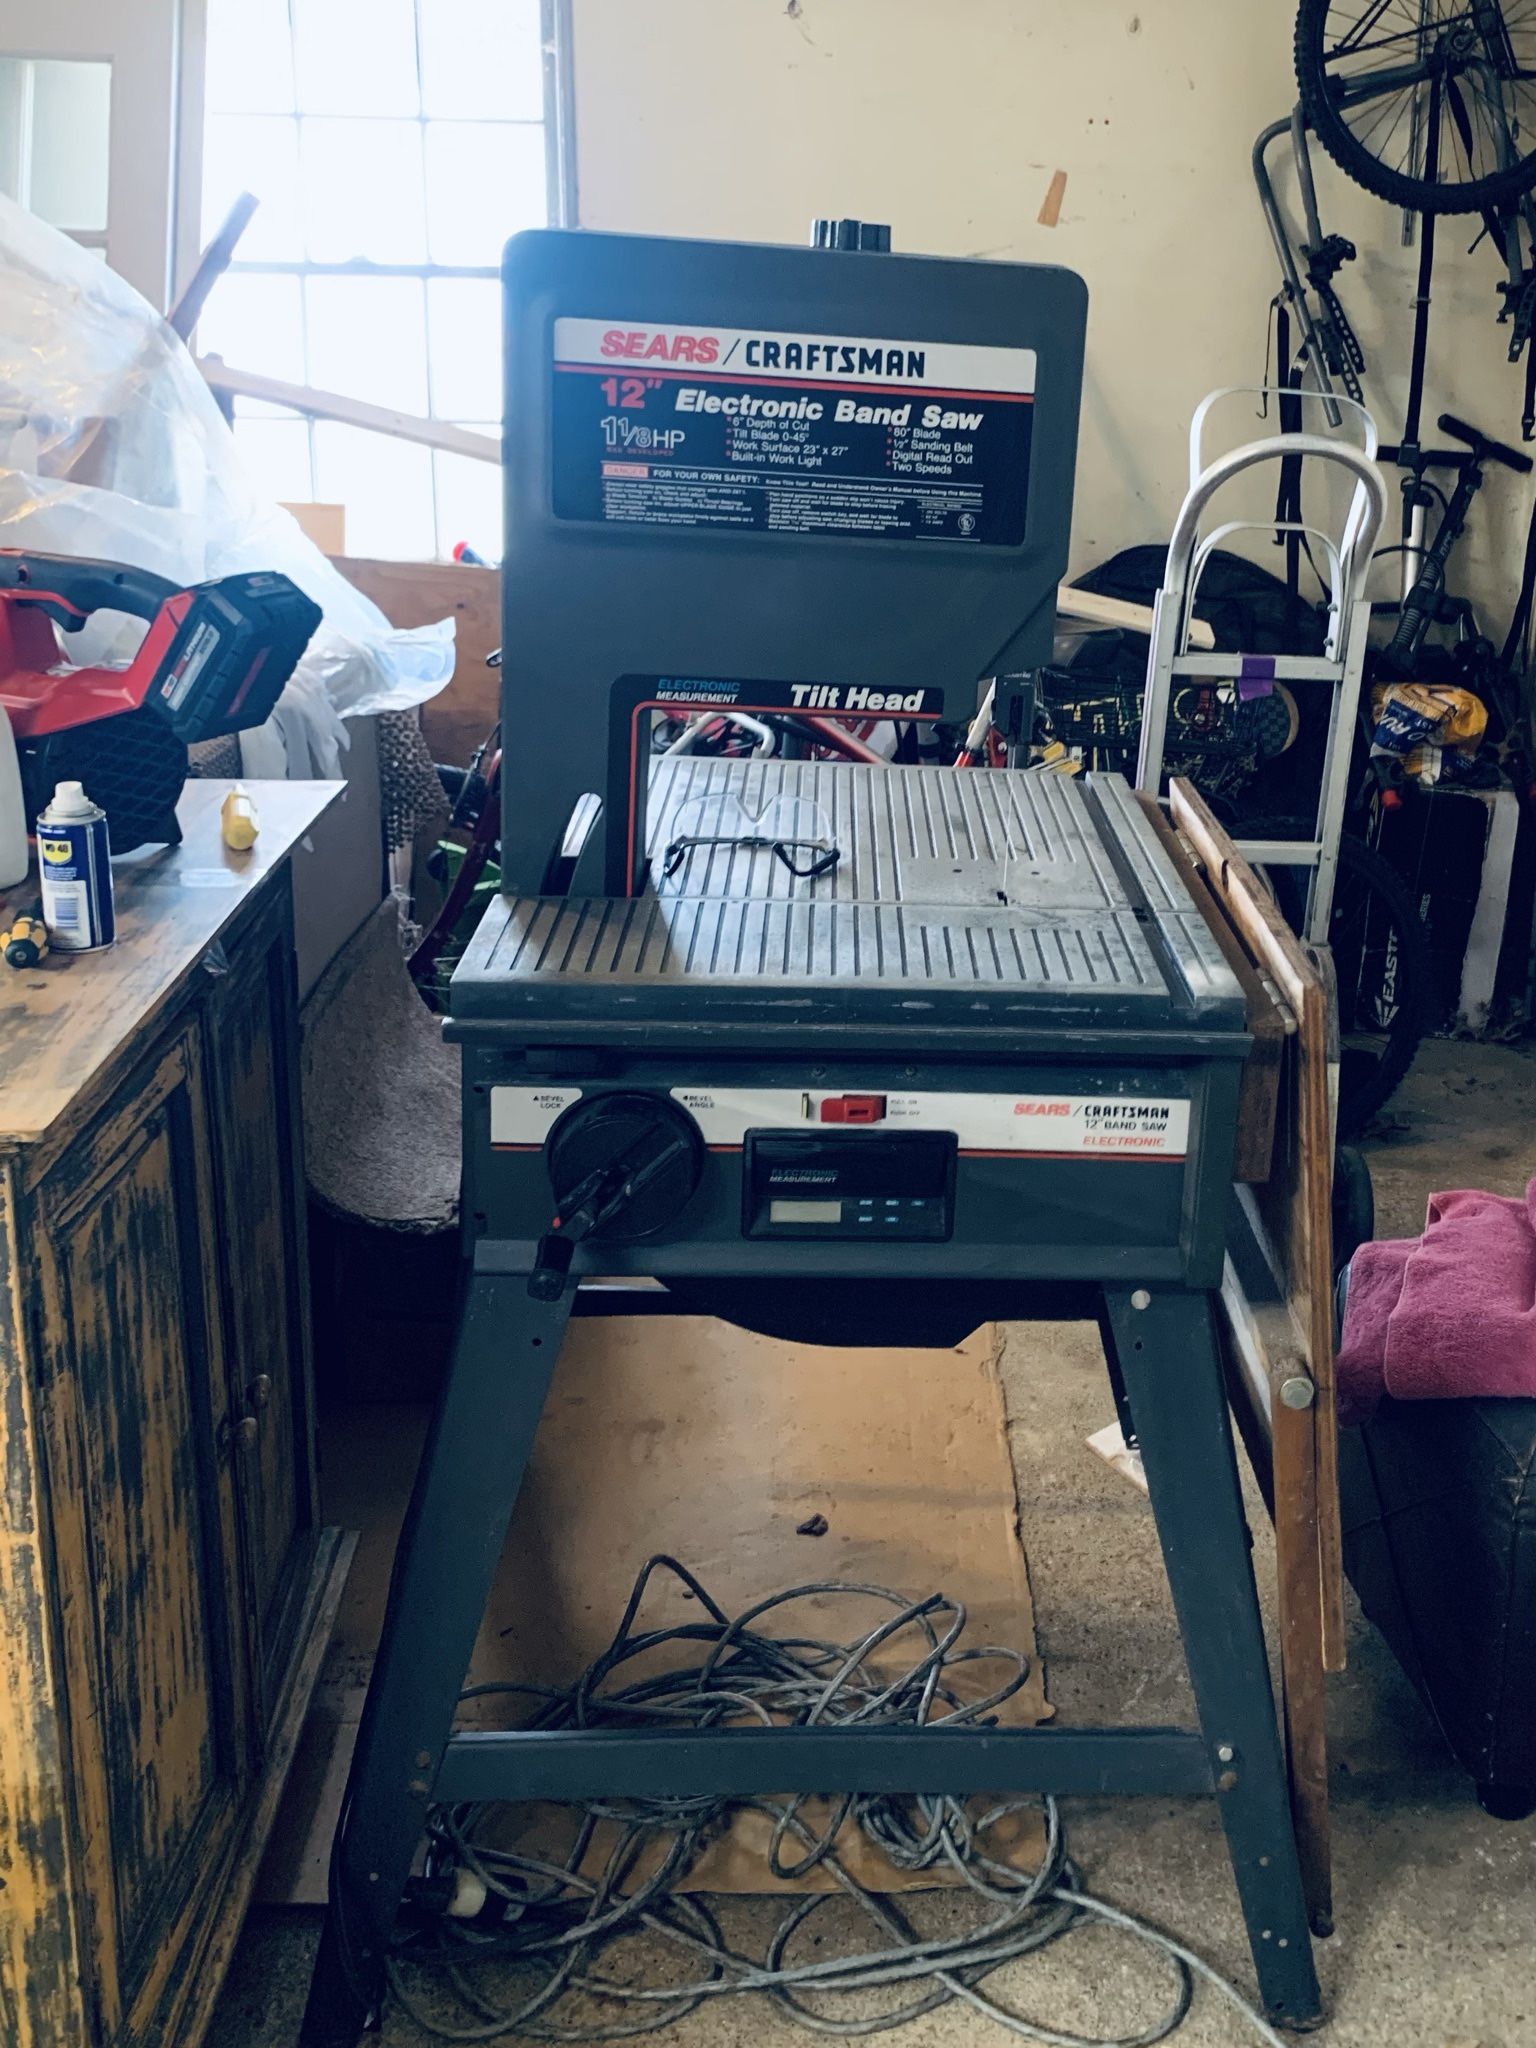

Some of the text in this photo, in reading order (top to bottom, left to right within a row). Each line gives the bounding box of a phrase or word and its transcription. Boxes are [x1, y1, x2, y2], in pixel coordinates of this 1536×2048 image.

[601, 330, 721, 365] SEARS
[745, 339, 926, 379] CRAFTSMAN
[600, 377, 664, 409] 12"
[674, 387, 985, 431] Electronic Band Saw
[746, 417, 776, 430] Depth
[779, 419, 790, 430] of
[791, 420, 811, 431] Cut
[732, 428, 748, 439] Tilt
[750, 429, 780, 441] Blade
[913, 427, 942, 440] Blade
[732, 439, 759, 451] Work
[761, 441, 800, 453] Surface
[910, 439, 951, 454] Sanding
[953, 441, 974, 453] Belt
[731, 450, 823, 468] Built-in Work Light
[892, 450, 974, 465] Digital Read Out
[892, 461, 952, 475] Two Speeds
[653, 470, 672, 479] FOR
[674, 471, 699, 480] YOUR
[700, 472, 723, 482] OWN
[724, 474, 760, 484] SAFETY:
[657, 679, 741, 693] ELECTRONIC
[655, 690, 739, 704] MEASUREMENT
[790, 683, 925, 713] Tilt Head
[540, 1095, 565, 1103] BEVEL
[689, 1101, 715, 1109] ANGLE
[1013, 1102, 1071, 1118] SEARS
[1084, 1104, 1170, 1120] CRAFTSMAN
[1104, 1120, 1138, 1131] BAND
[1141, 1121, 1168, 1133] SAW
[1083, 1134, 1167, 1148] ELECTRONIC
[768, 1175, 838, 1183] MEASUREMENT
[771, 1168, 839, 1177] ELECTRONIC
